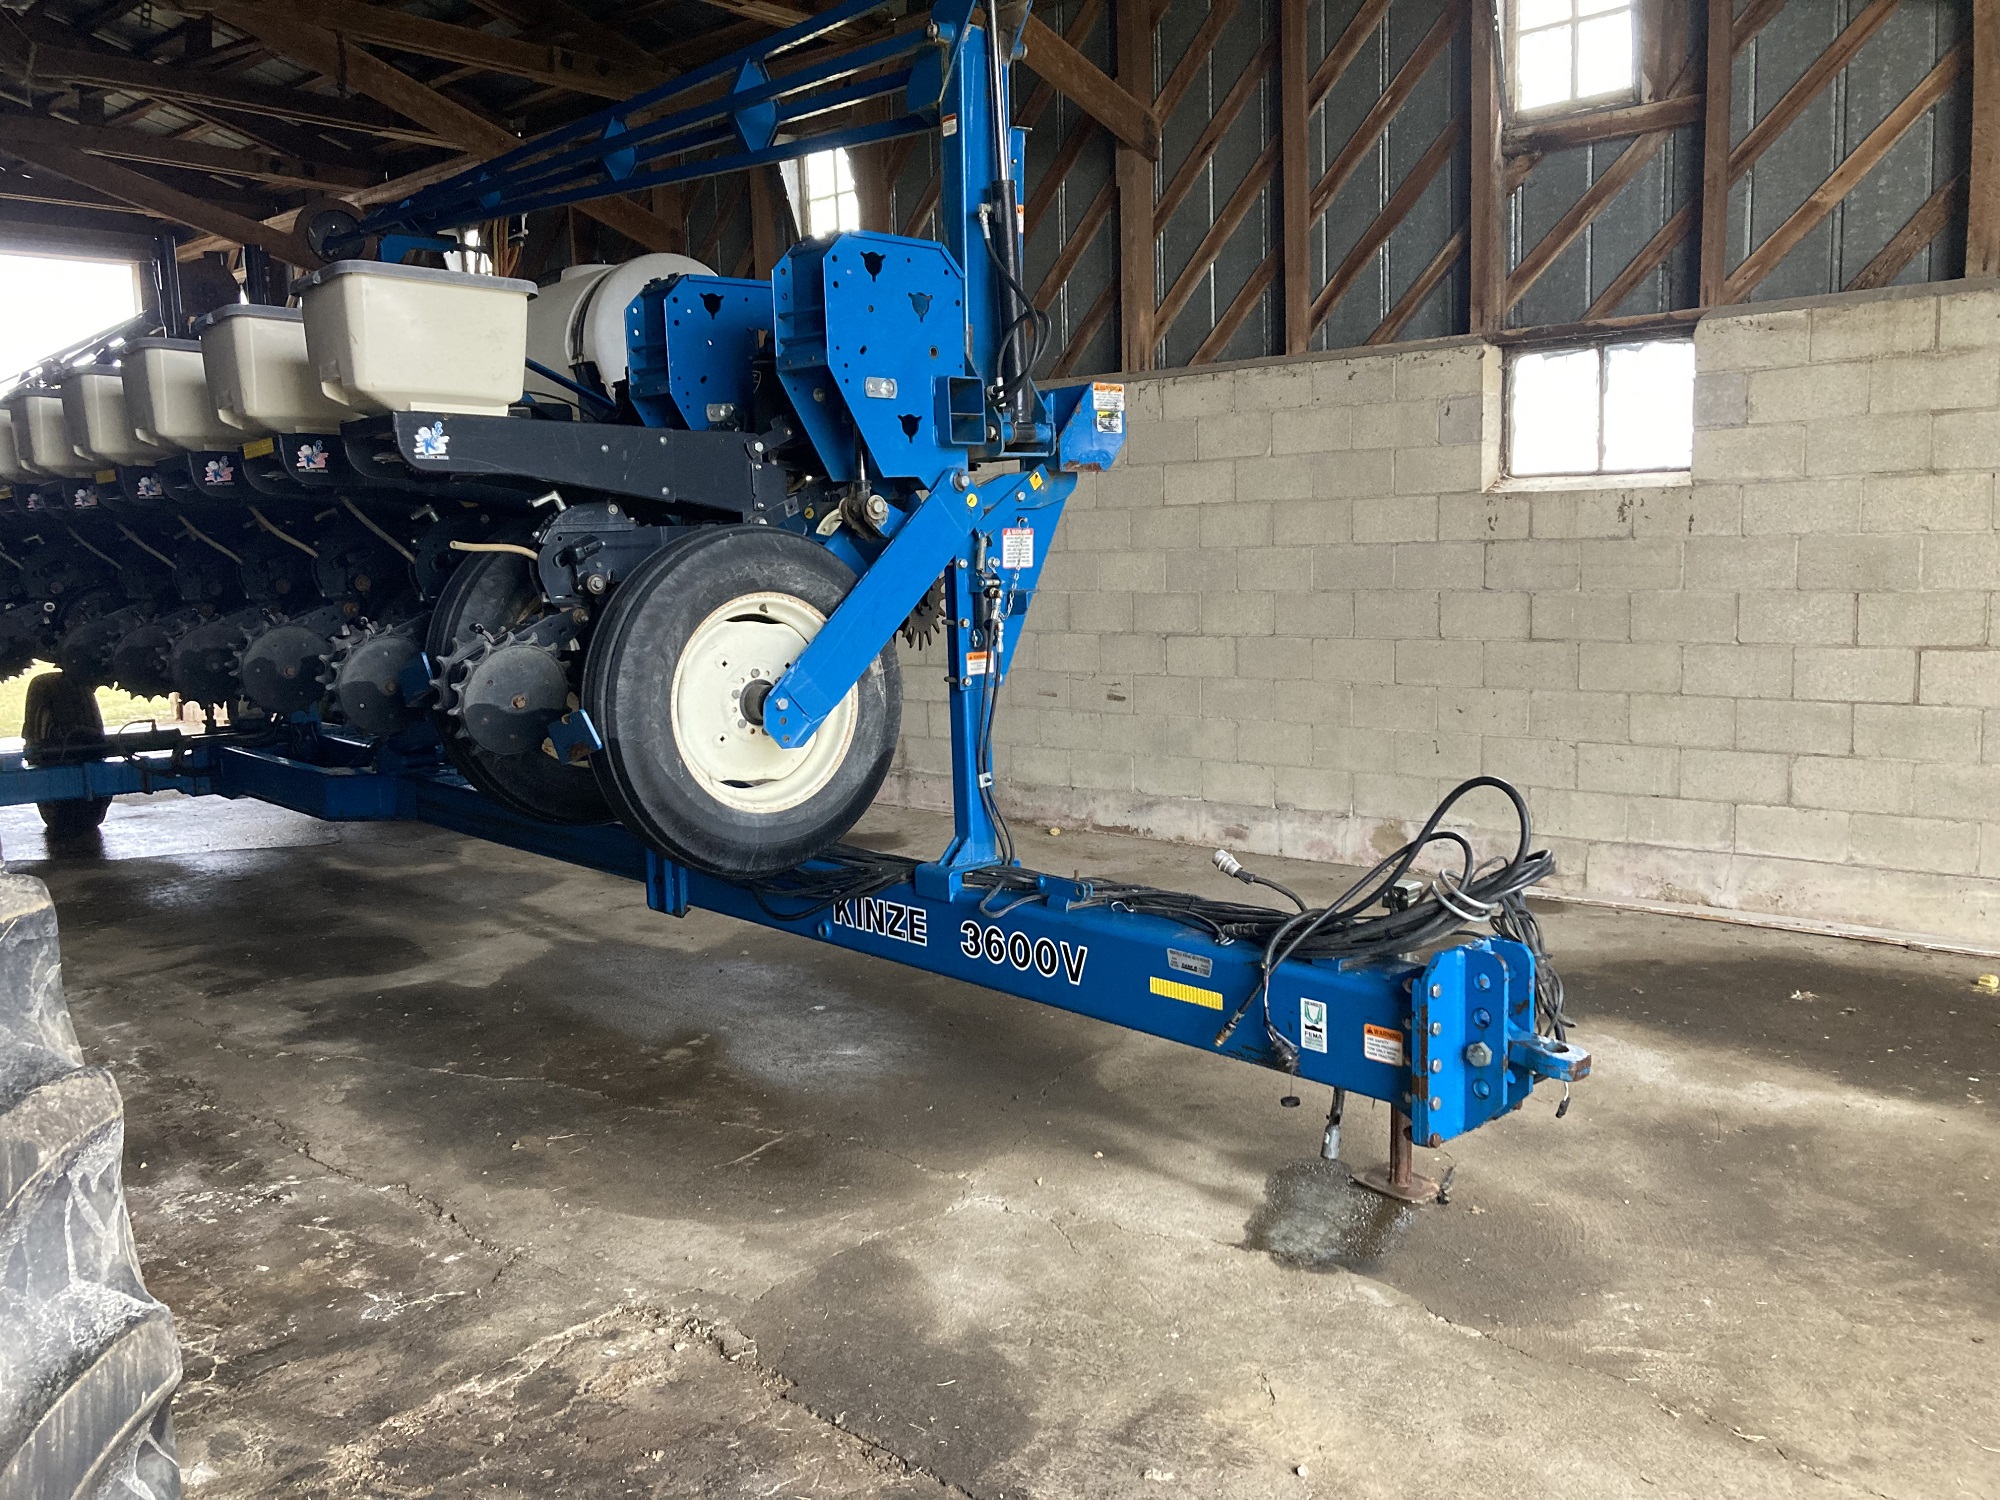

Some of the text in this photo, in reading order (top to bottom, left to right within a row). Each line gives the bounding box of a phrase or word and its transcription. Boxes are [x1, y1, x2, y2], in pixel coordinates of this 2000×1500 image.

[833, 896, 1088, 986] KINZE 3600V
[1304, 1030, 1323, 1041] FEMA
[1373, 1028, 1402, 1041] WARNING
